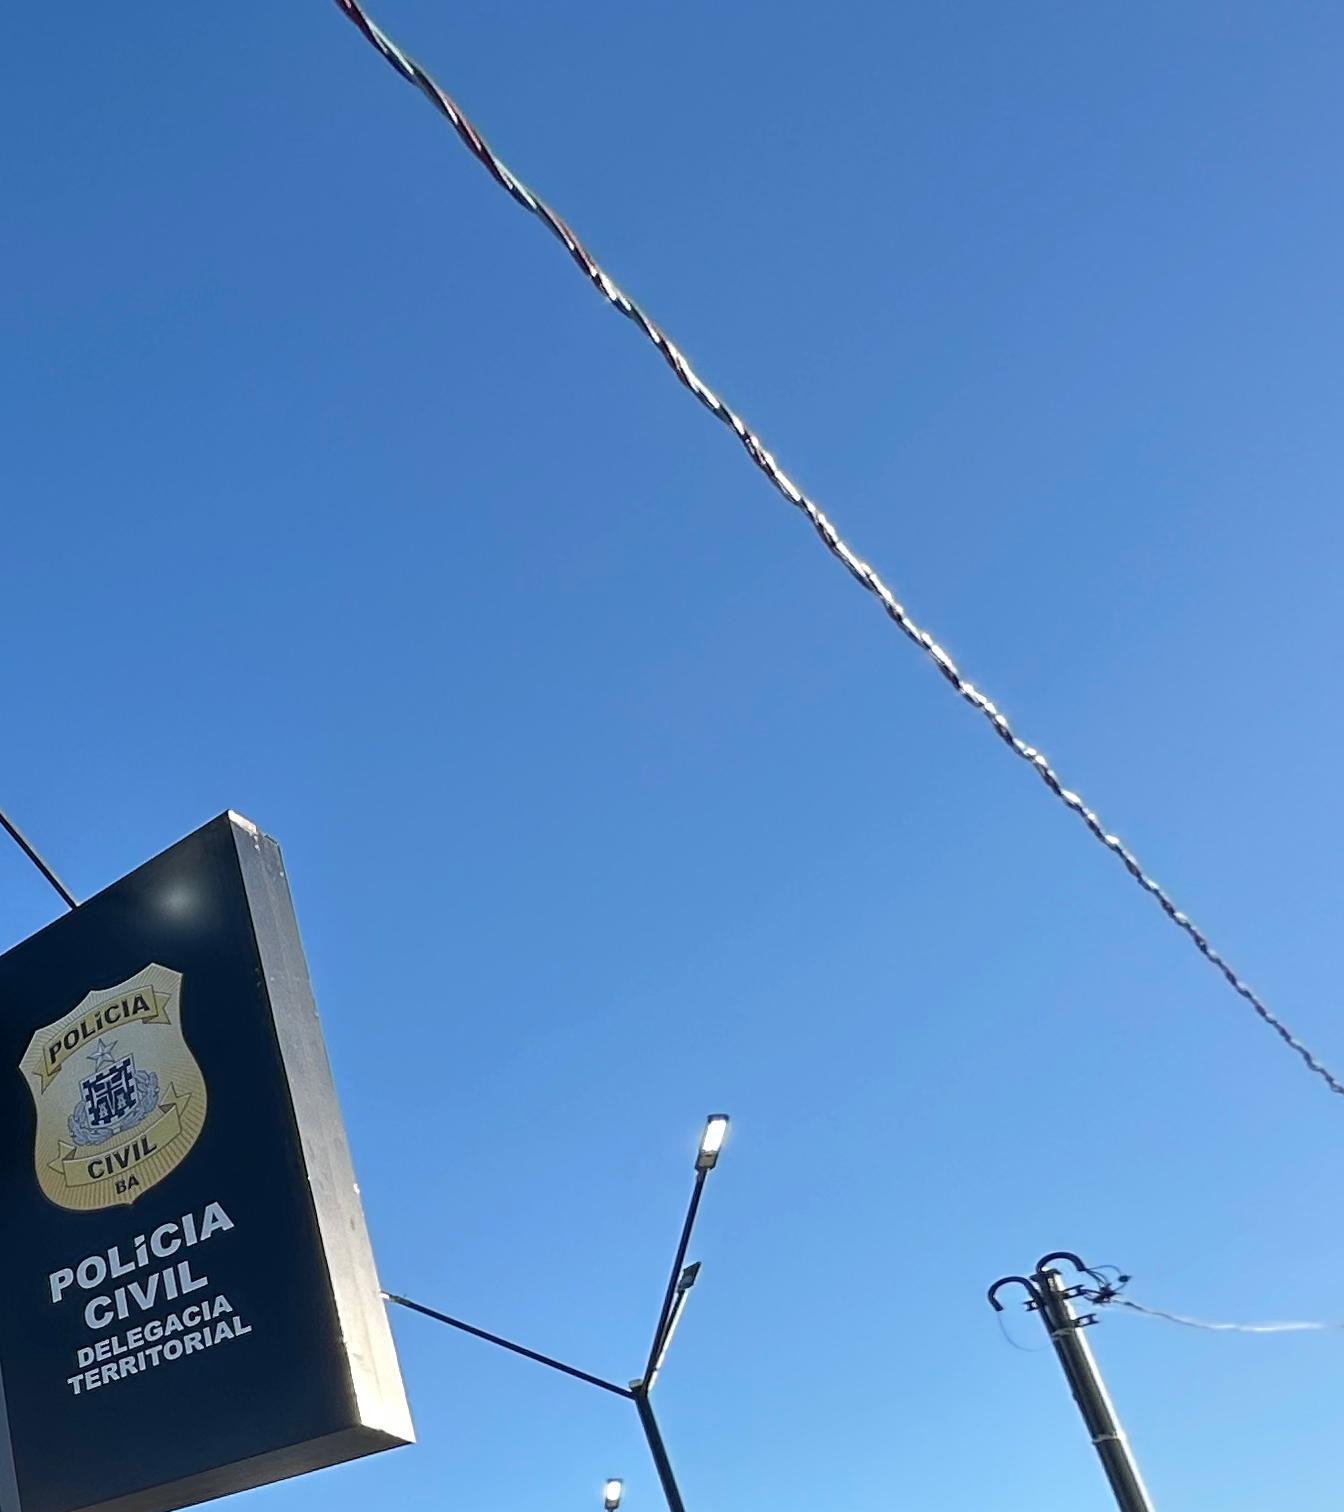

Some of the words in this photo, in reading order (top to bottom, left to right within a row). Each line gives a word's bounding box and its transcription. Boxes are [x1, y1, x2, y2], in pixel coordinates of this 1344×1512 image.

[87, 1134, 158, 1180] CIVIL
[114, 1173, 140, 1195] BA
[84, 1260, 209, 1330] CIVIL
[66, 1315, 253, 1396] TERRITORIAL
[76, 1294, 234, 1369] DELEGACIA
